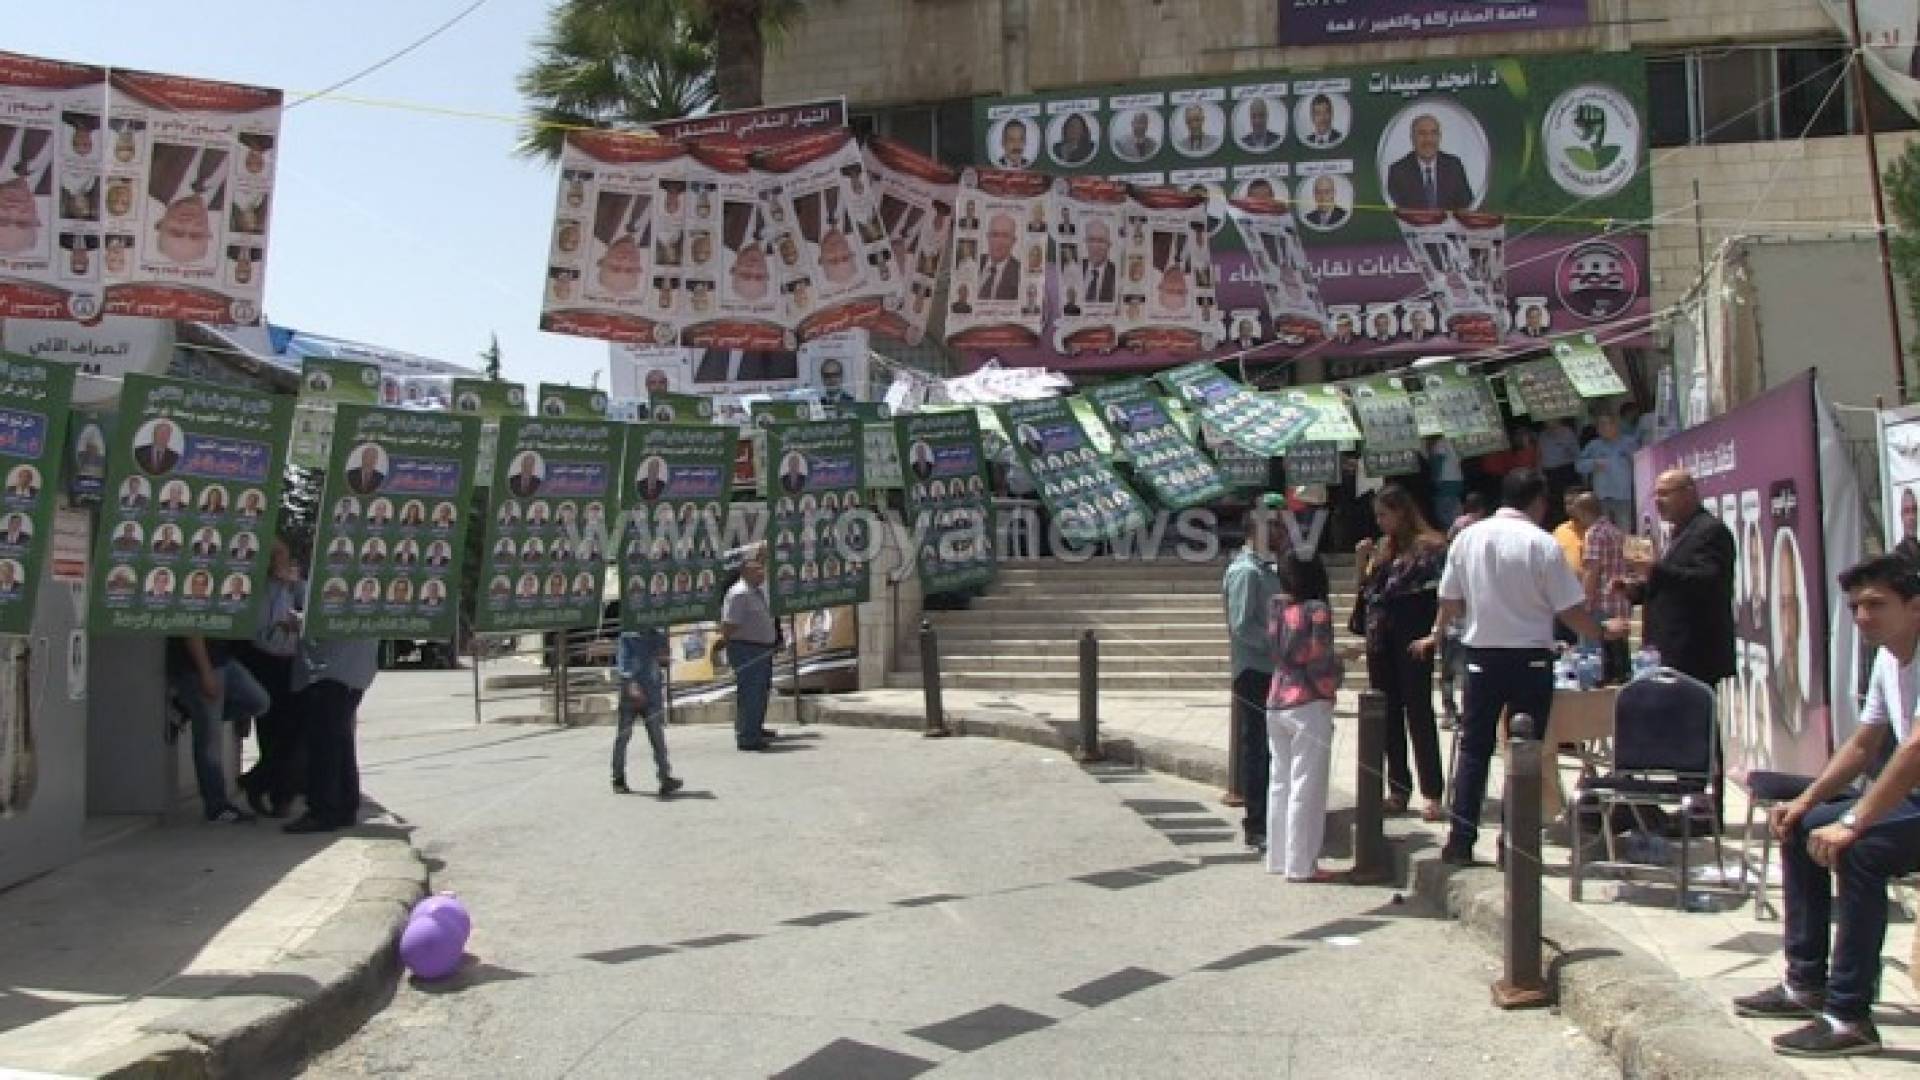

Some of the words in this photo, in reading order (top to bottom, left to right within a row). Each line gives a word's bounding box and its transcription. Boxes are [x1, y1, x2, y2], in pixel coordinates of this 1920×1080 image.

[1422, 8, 1494, 28] المشاركة
[1368, 72, 1433, 98] عبيدات
[1309, 257, 1352, 279] نقاب
[69, 338, 130, 357] الصراف
